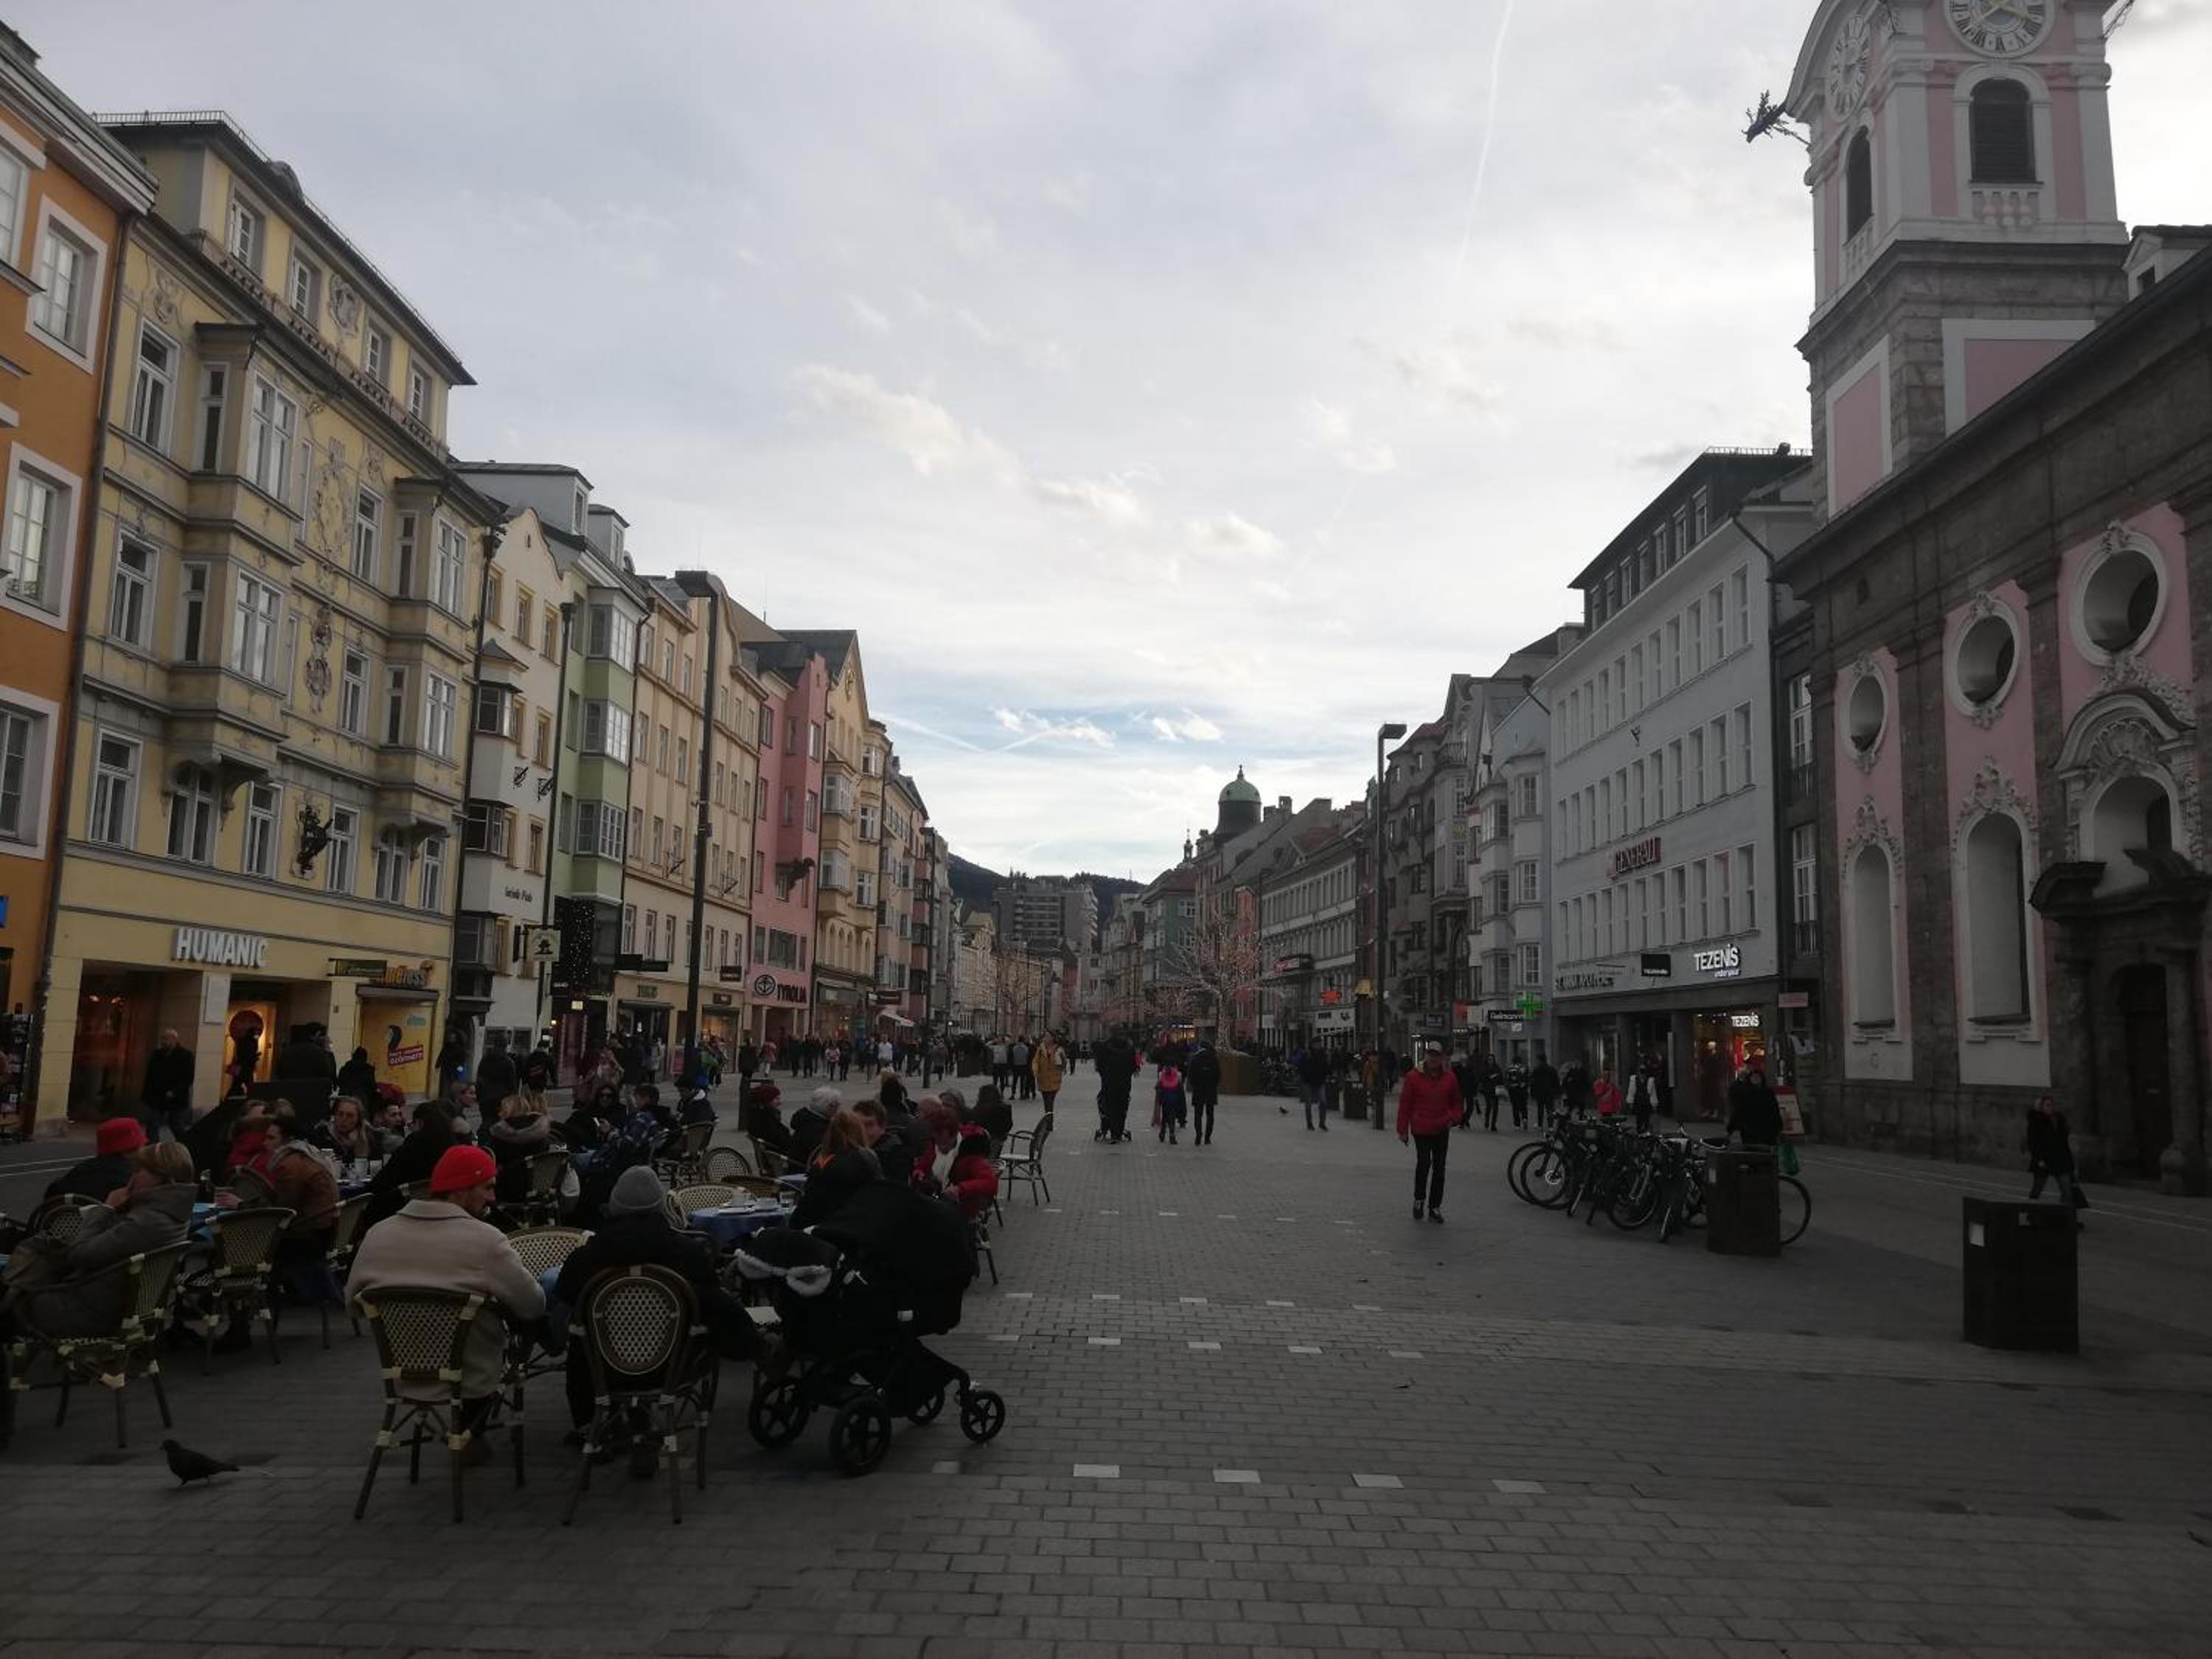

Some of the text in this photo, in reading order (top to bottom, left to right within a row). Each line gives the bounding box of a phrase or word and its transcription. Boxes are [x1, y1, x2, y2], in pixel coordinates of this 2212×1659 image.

[175, 928, 269, 968] HUMANIC
[1693, 943, 1739, 971] TEZENIS
[777, 983, 807, 1004] TYROLIA
[1731, 1011, 1760, 1027] TEZENIS
